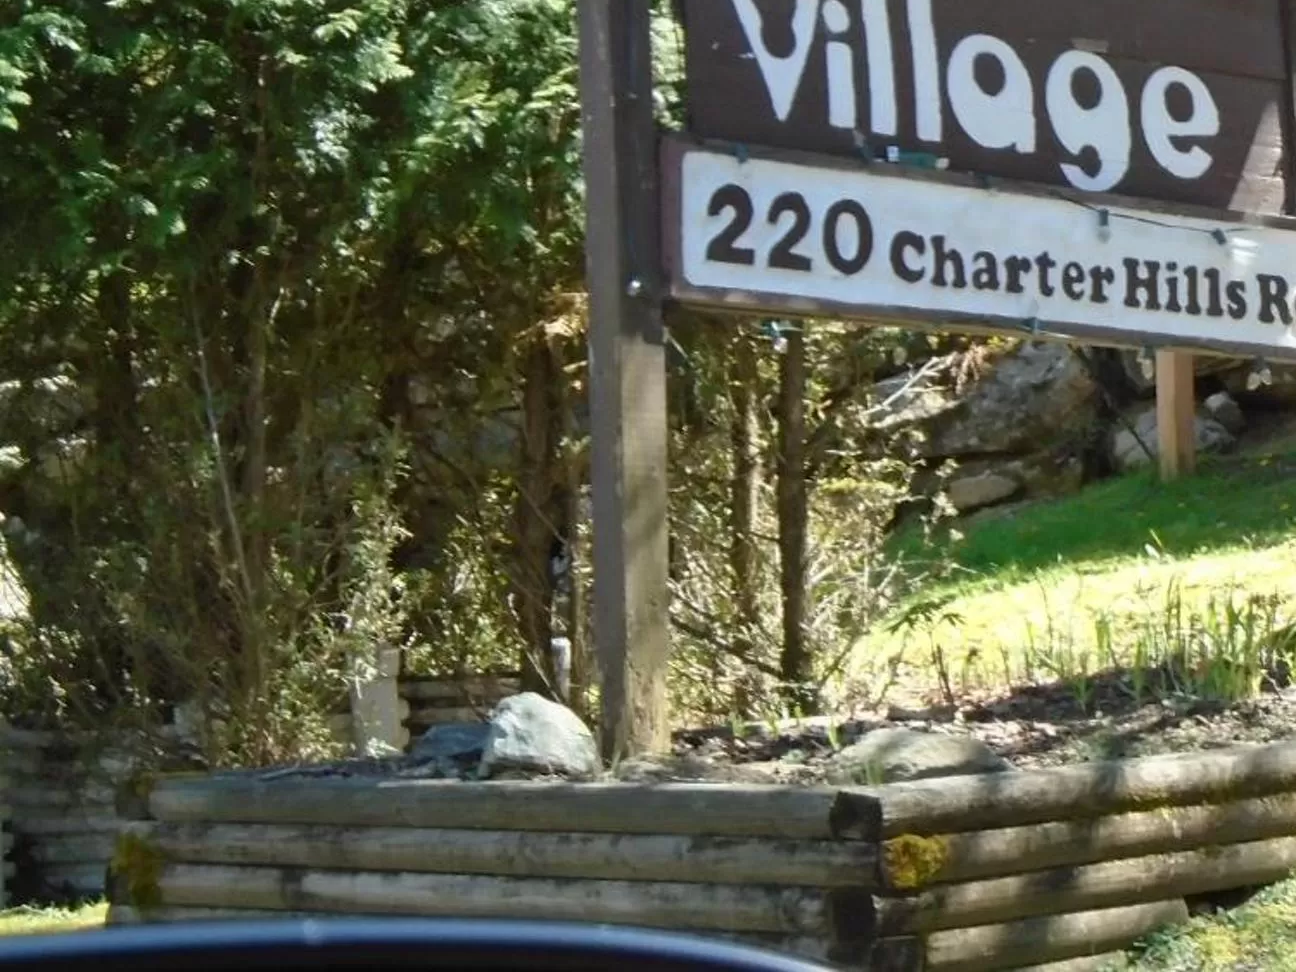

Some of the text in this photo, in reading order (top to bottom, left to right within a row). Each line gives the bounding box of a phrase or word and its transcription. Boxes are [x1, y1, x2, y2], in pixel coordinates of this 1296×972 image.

[706, 184, 873, 275] 220
[889, 231, 1116, 305] Charter
[1122, 259, 1247, 321] Hills
